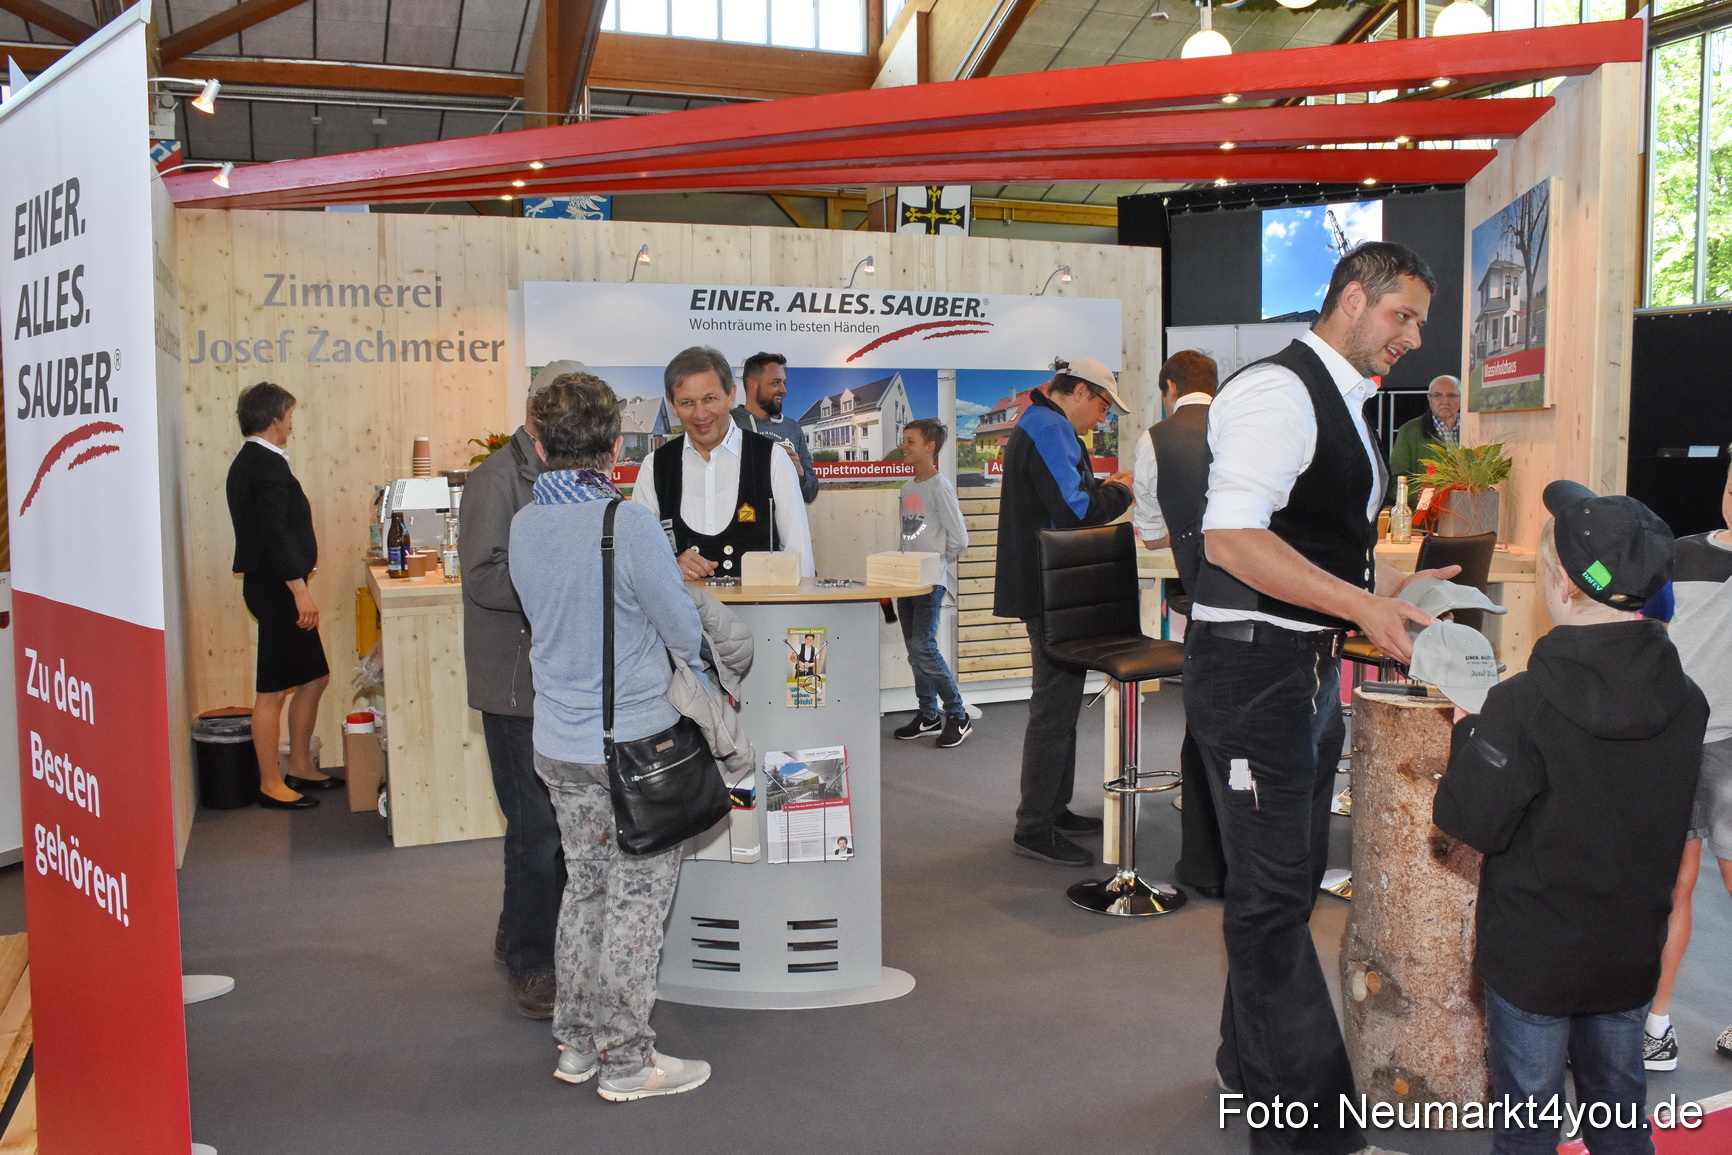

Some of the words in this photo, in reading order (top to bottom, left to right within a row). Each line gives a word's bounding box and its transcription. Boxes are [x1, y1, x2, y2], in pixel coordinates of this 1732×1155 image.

[14, 177, 86, 261] EINER.
[14, 264, 90, 340] ALLES.
[263, 273, 443, 308] Zimmerei
[690, 289, 780, 312] EINER.
[787, 292, 875, 315] ALLES.
[190, 329, 295, 364] Josef
[307, 329, 505, 364] Zachmeier
[689, 318, 772, 332] Wohnträume
[776, 319, 787, 332] in
[790, 320, 831, 333] besten
[834, 321, 880, 334] Händen
[1582, 571, 1604, 591] DATEV
[25, 648, 50, 704] Zu
[54, 658, 95, 725] den
[30, 730, 100, 818] Besten
[35, 823, 129, 927] gehören!
